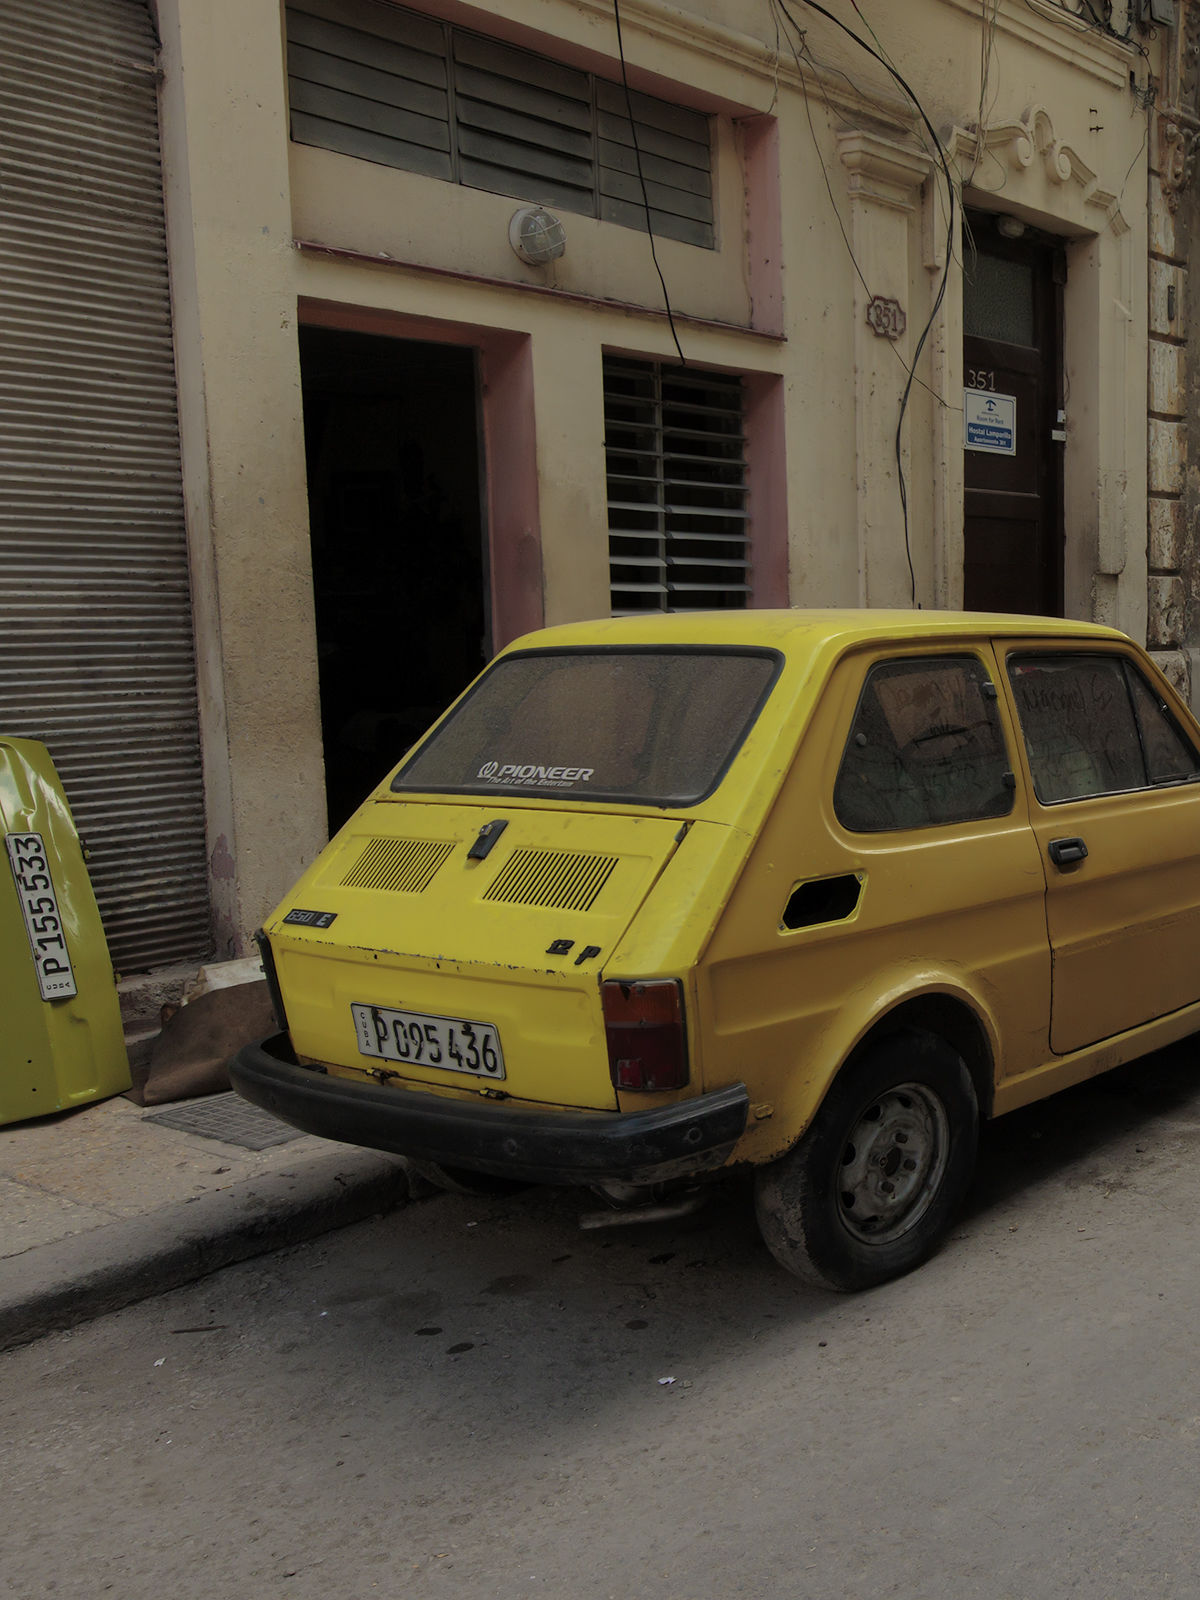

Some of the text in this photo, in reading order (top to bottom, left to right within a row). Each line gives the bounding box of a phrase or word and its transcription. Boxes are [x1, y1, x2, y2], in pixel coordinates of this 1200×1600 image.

[968, 368, 996, 391] 351
[497, 765, 594, 781] PIONEER
[285, 911, 332, 926] 650 E
